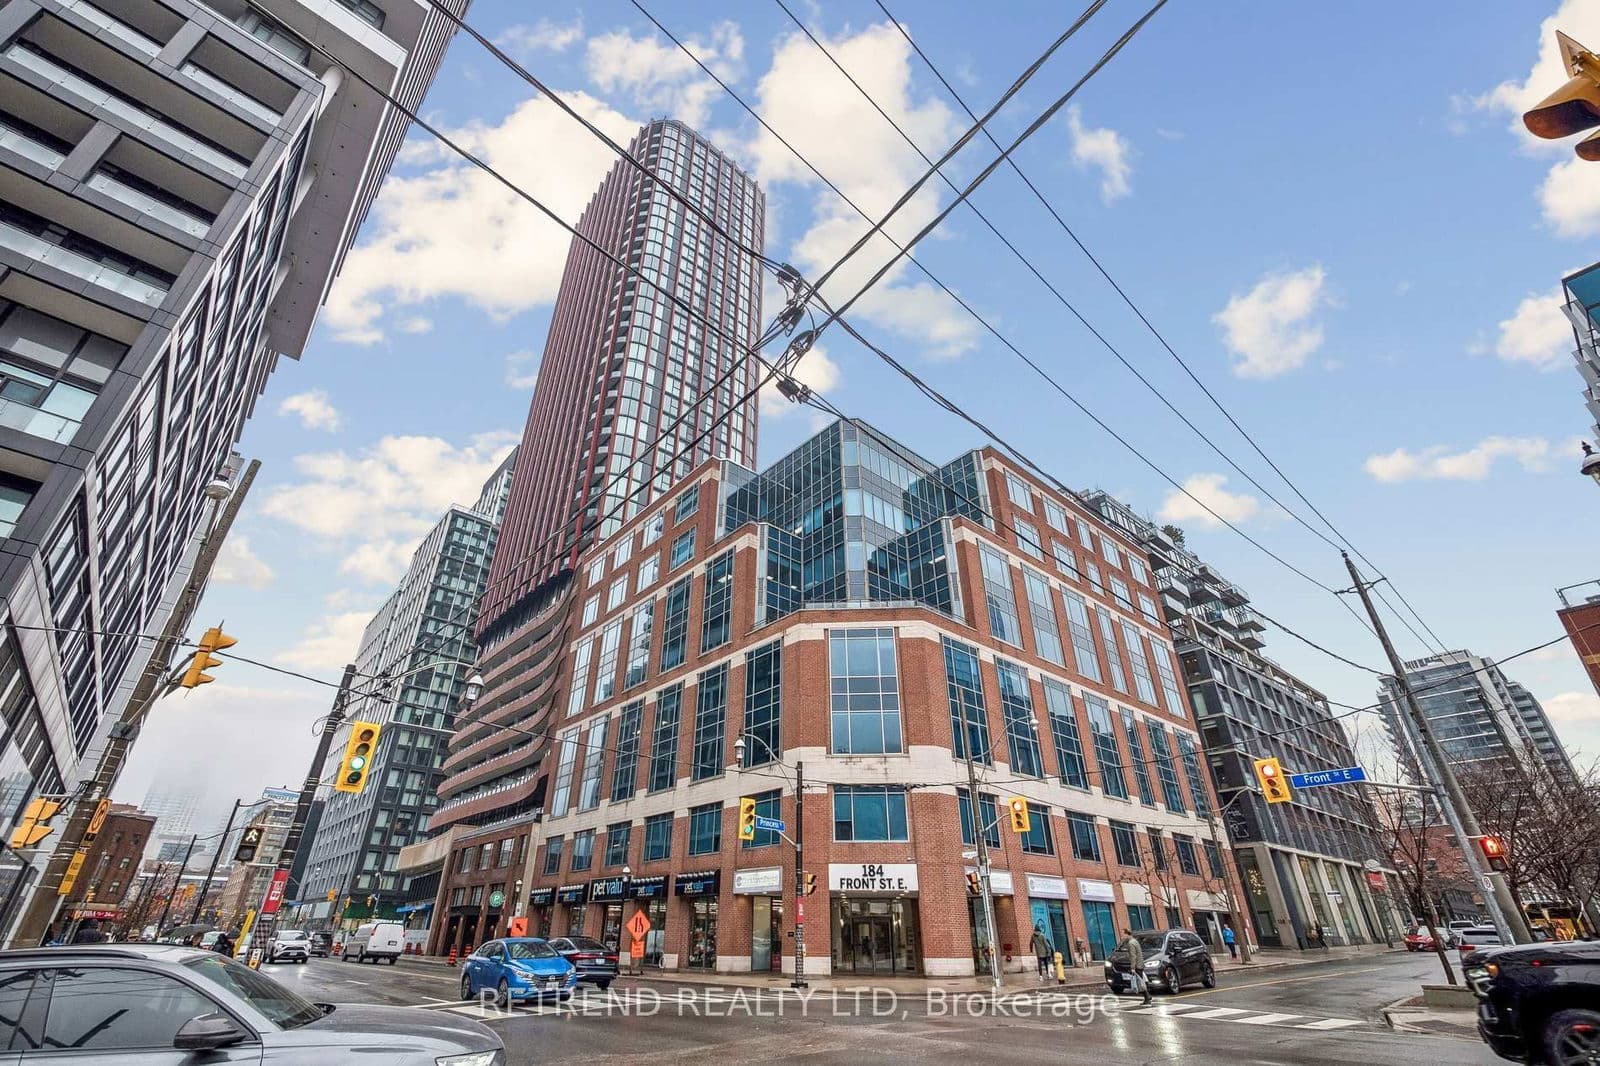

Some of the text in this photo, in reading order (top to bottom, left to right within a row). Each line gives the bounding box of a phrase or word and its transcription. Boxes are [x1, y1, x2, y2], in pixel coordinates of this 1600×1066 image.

[1303, 773, 1332, 784] Front
[1343, 770, 1351, 779] E
[862, 865, 884, 877] 184
[839, 878, 908, 889] FRONT ST. E.
